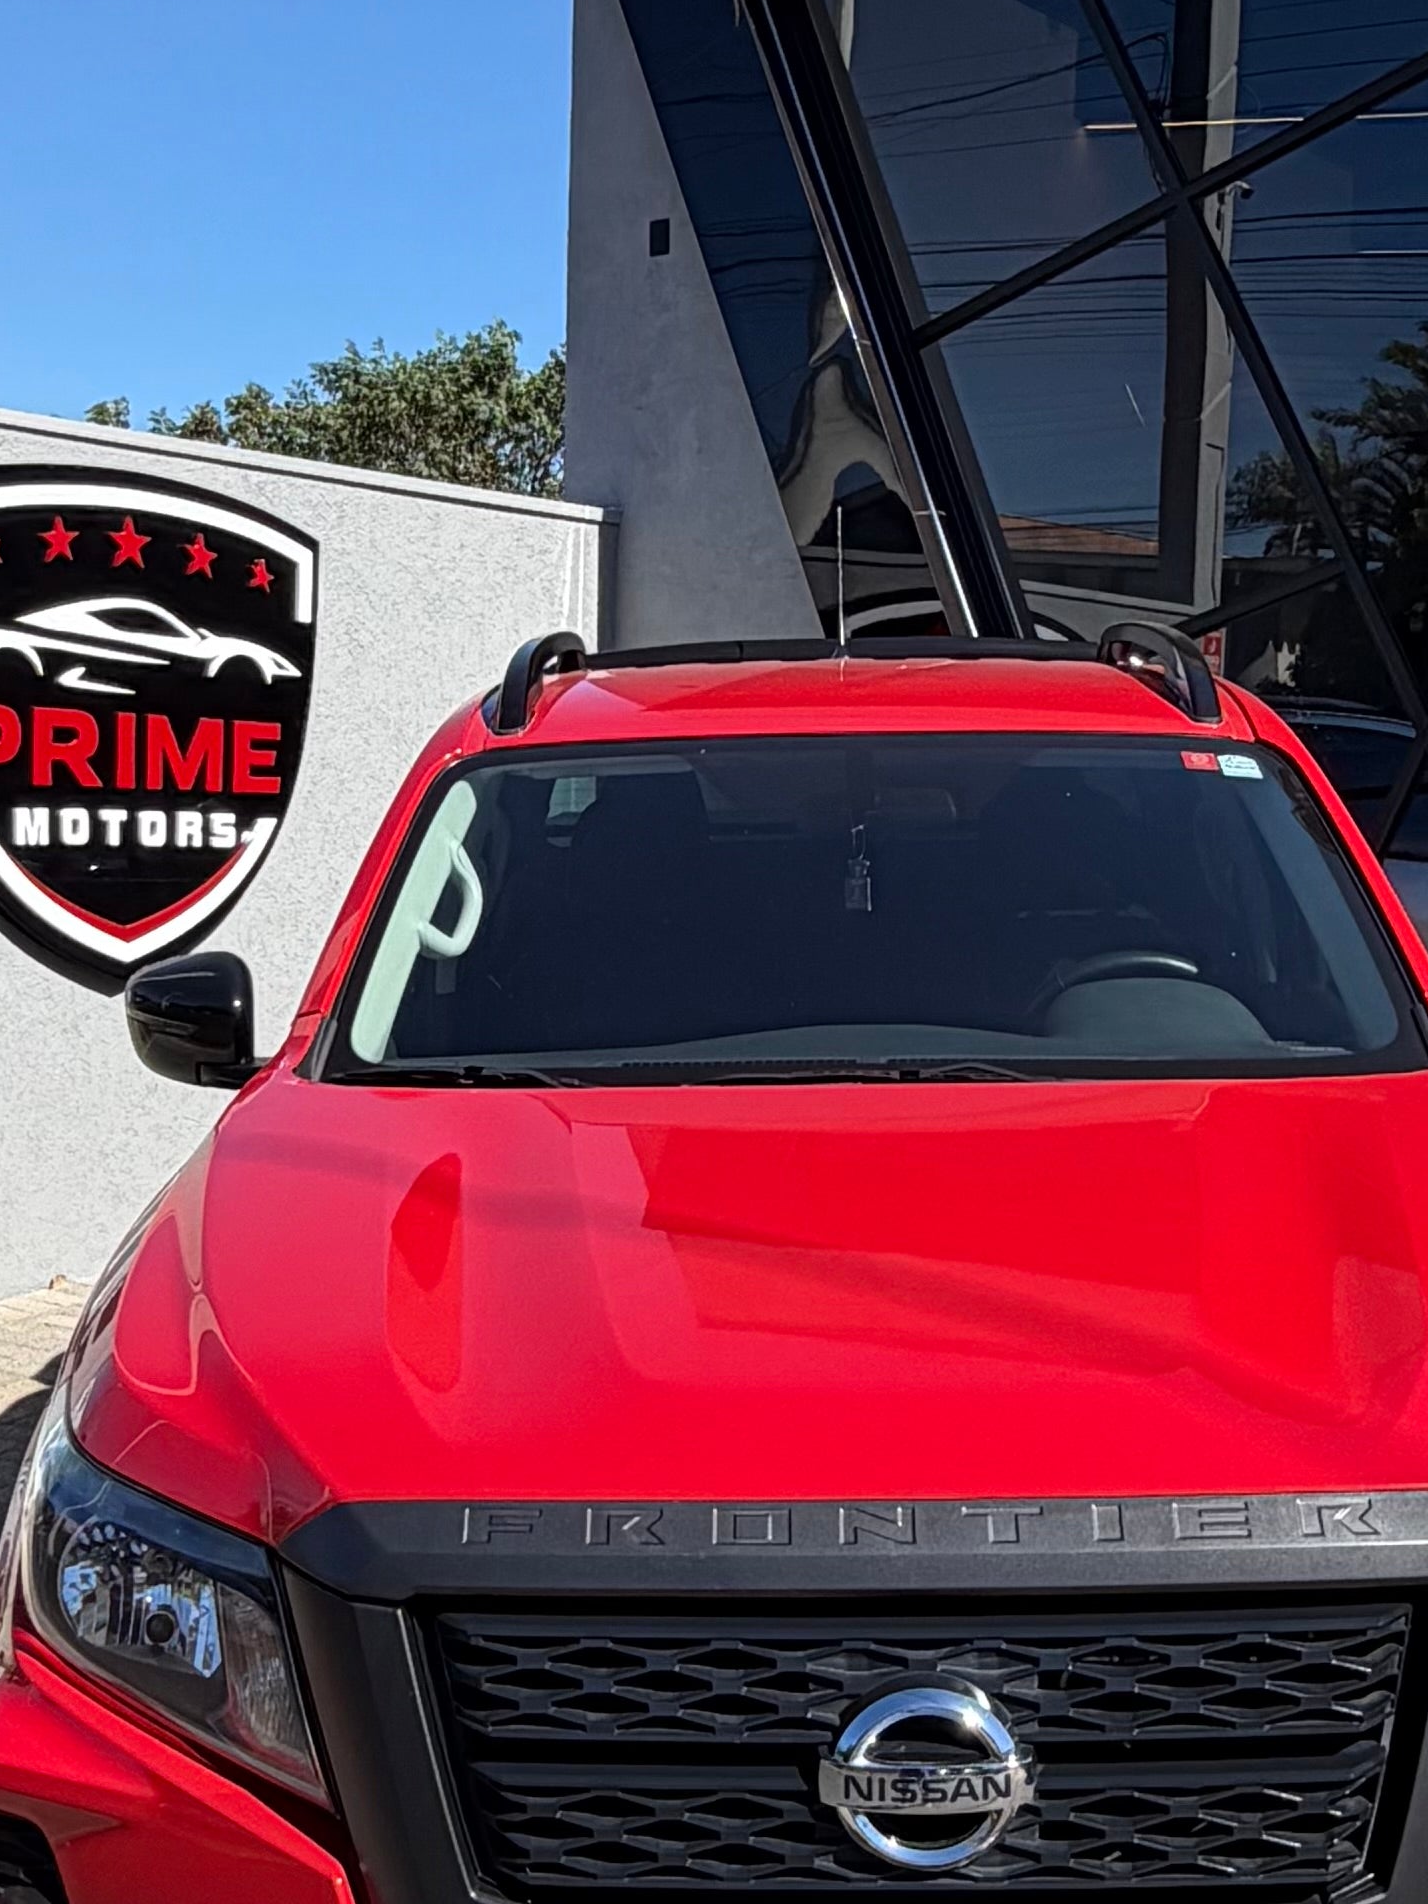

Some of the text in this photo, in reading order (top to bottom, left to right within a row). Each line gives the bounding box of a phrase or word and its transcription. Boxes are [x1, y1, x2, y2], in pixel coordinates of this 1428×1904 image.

[13, 807, 237, 849] MOTORS
[461, 1498, 1381, 1546] FRONTIER
[843, 1773, 1012, 1803] NISSAN
